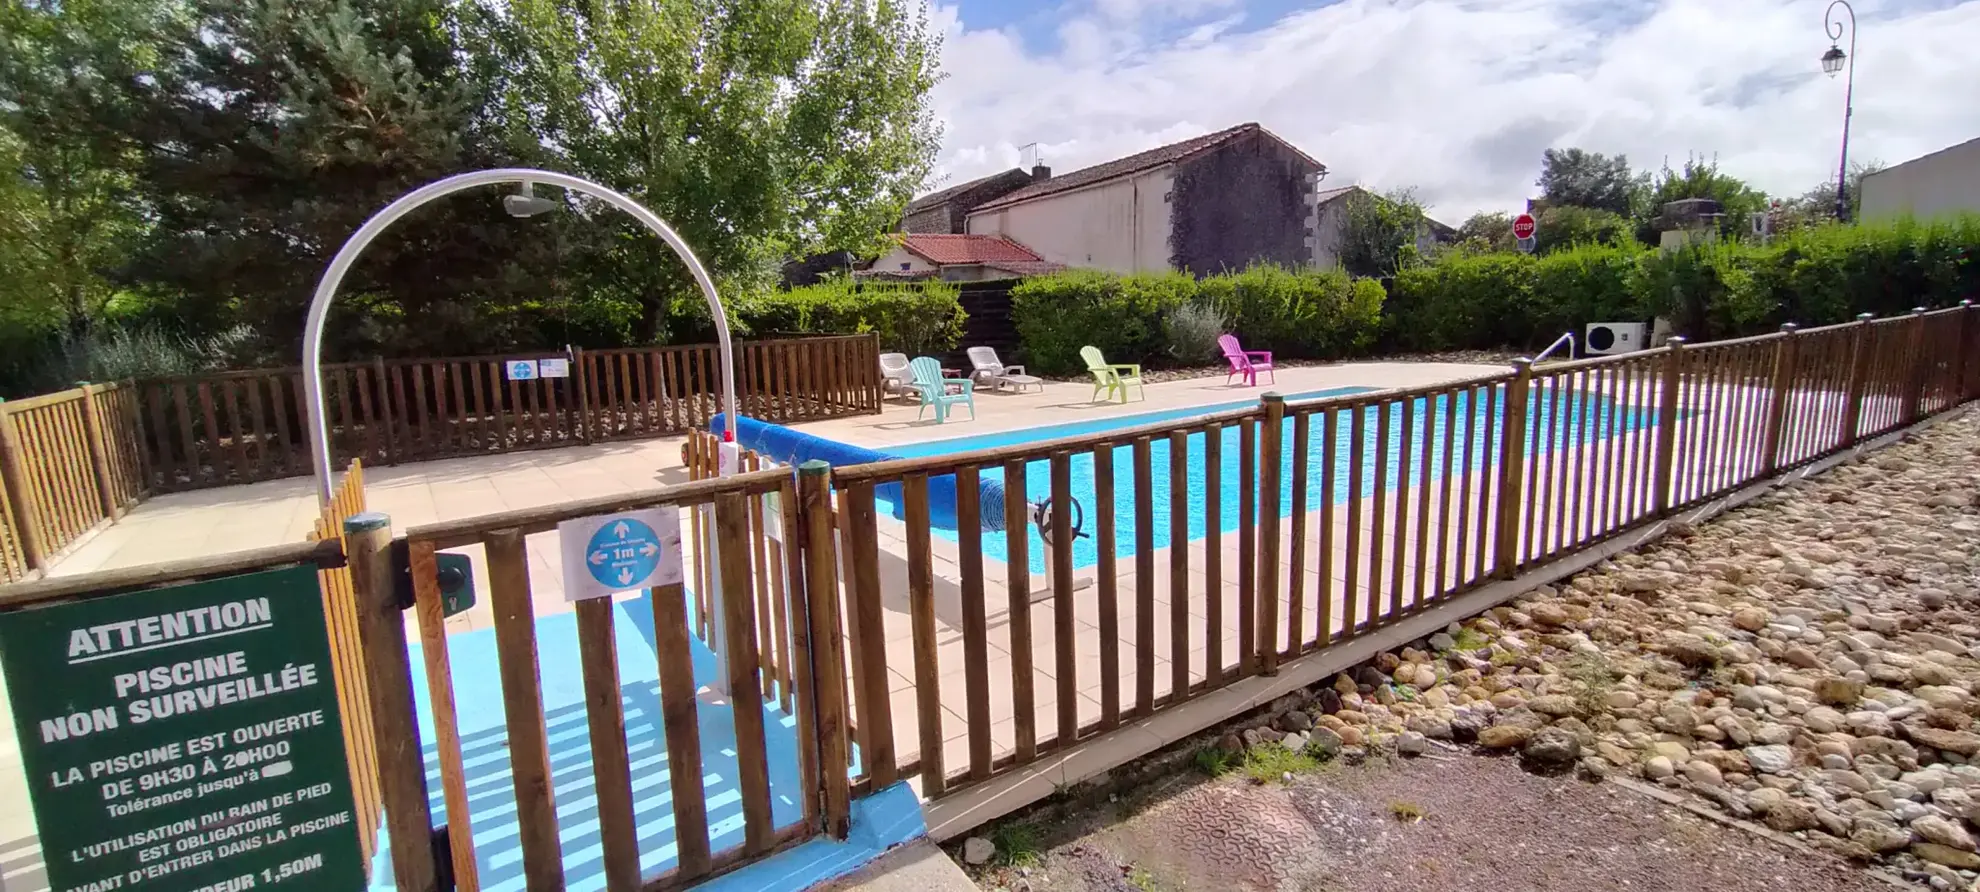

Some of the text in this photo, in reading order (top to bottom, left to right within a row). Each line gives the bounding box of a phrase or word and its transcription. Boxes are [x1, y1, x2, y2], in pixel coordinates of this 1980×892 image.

[1516, 222, 1532, 231] STOP
[613, 548, 634, 560] 1m
[67, 597, 271, 657] ATTENTION
[114, 651, 248, 697] PISCINE
[40, 662, 318, 742] NON SURVEILLÉE
[51, 709, 324, 788] LA PISCINE EST OUVERTE
[101, 779, 134, 801] DE
[139, 763, 196, 792] 9H30
[202, 756, 219, 777] À
[106, 769, 259, 818] Tolérance jusqu'à
[72, 818, 197, 862] L'UTILISATION
[272, 795, 294, 809] DE
[297, 781, 332, 802] PIED
[139, 812, 283, 863] EST OBLIGATOIRE
[129, 850, 214, 884] D'ENTRER
[218, 835, 262, 858] DANS
[266, 829, 287, 844] LA
[290, 810, 350, 839] PISCINE
[261, 853, 323, 883] 1,50M
